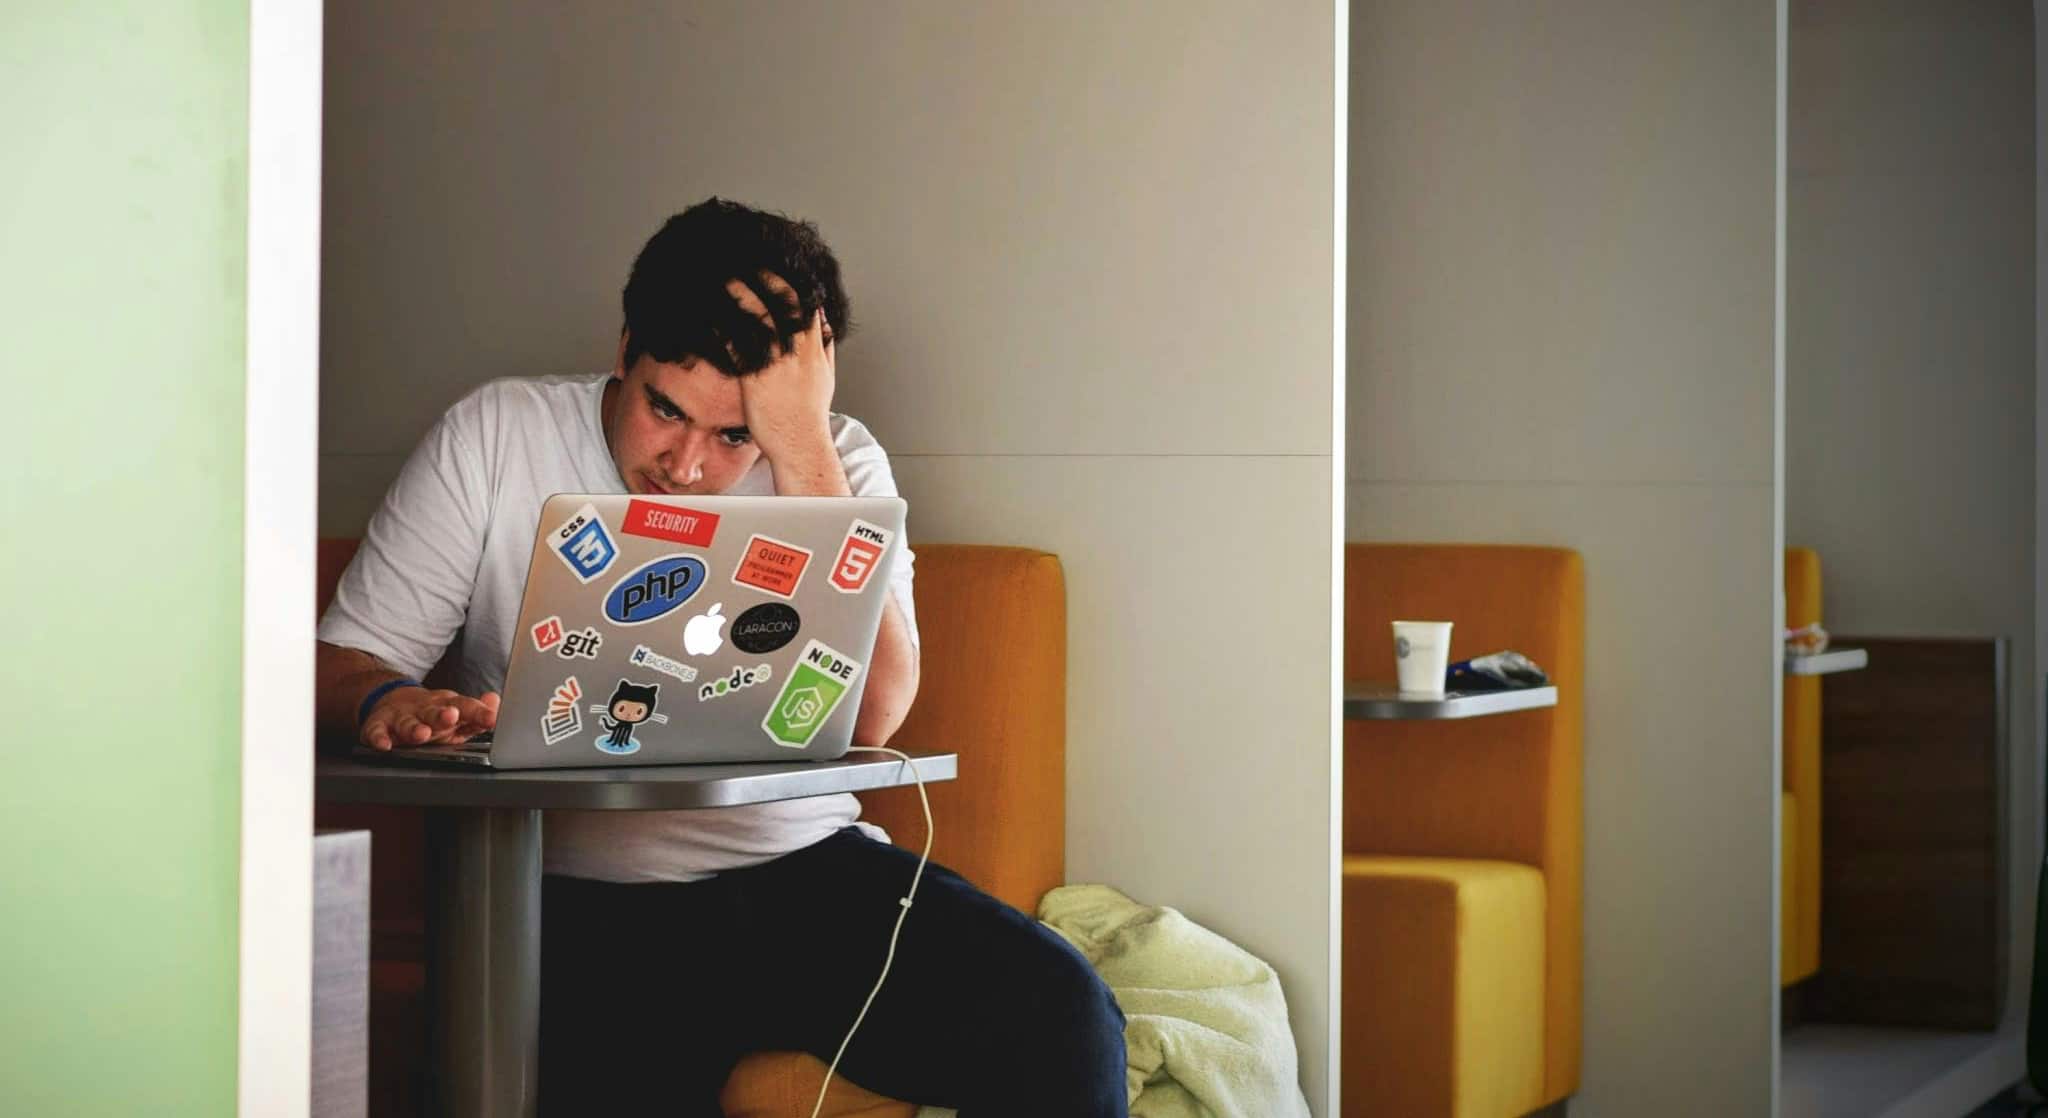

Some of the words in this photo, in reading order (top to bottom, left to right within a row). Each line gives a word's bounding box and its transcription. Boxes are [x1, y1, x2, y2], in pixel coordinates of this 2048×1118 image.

[560, 516, 585, 538] CSS
[644, 509, 699, 535] SECURITY
[855, 525, 885, 544] HTML
[759, 548, 796, 567] QUIET
[841, 548, 873, 581] 5
[622, 565, 691, 618] php
[738, 620, 793, 636] LARACON
[560, 631, 600, 656] git
[808, 647, 854, 680] NODE
[782, 697, 815, 719] JS
